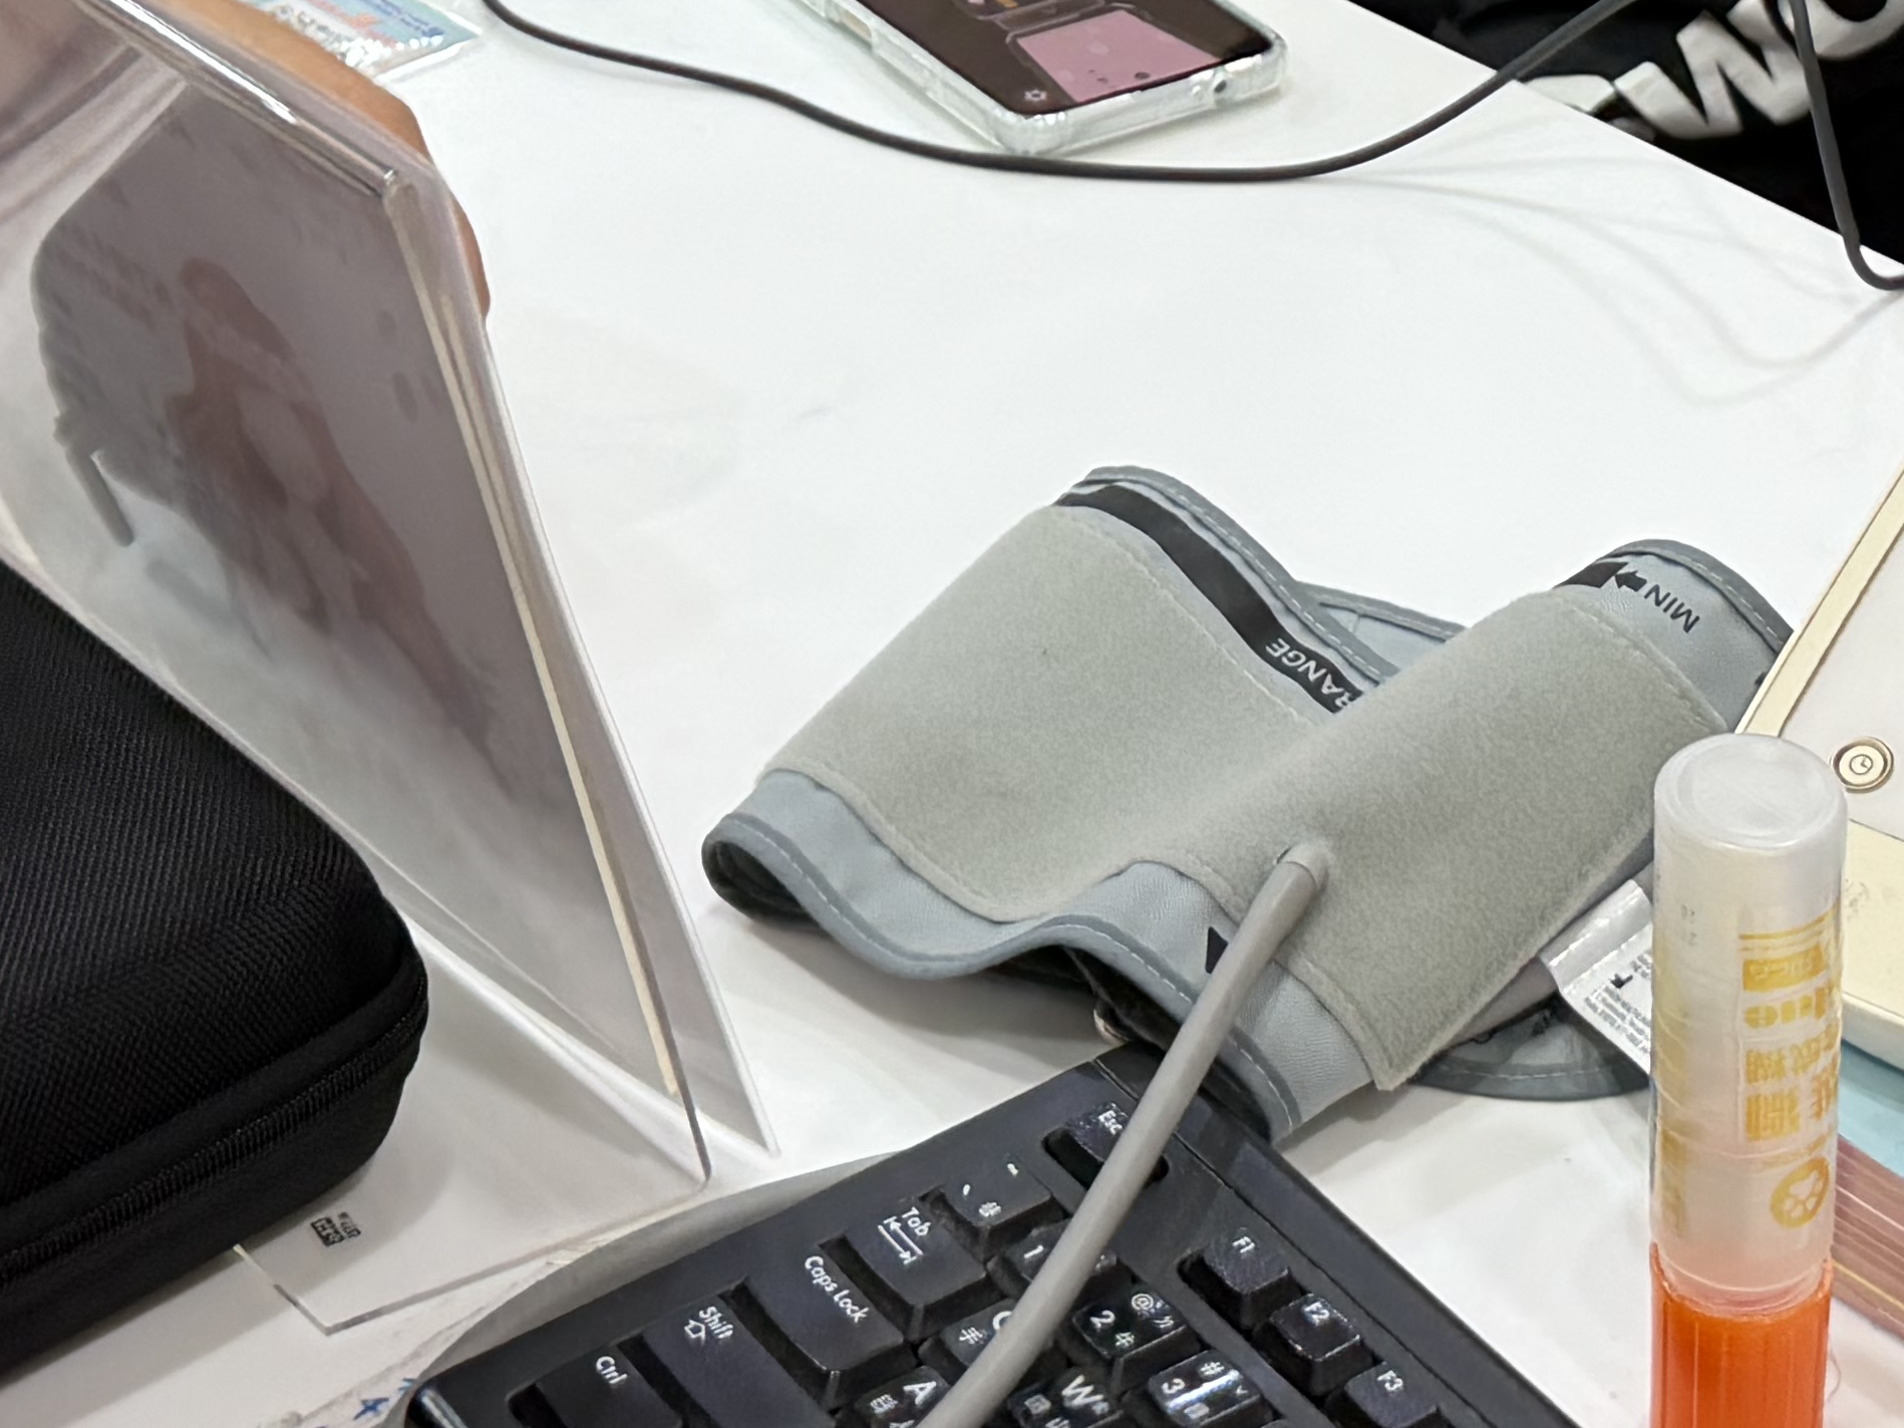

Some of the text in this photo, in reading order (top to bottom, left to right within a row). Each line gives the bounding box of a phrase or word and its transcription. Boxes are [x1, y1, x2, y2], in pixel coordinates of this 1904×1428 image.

[1646, 582, 1700, 634] MIN
[1265, 638, 1364, 709] RANGE
[1097, 1110, 1124, 1137] Esc
[901, 1207, 932, 1238] Tab
[1231, 1235, 1257, 1254] F1
[804, 1255, 868, 1324] Caps Lock
[698, 1305, 735, 1341] Shift
[1089, 1310, 1115, 1328] 2
[1304, 1302, 1330, 1324] F2
[595, 1355, 630, 1387] Ctrl
[1376, 1369, 1404, 1393] F3
[1162, 1379, 1186, 1395] 3
